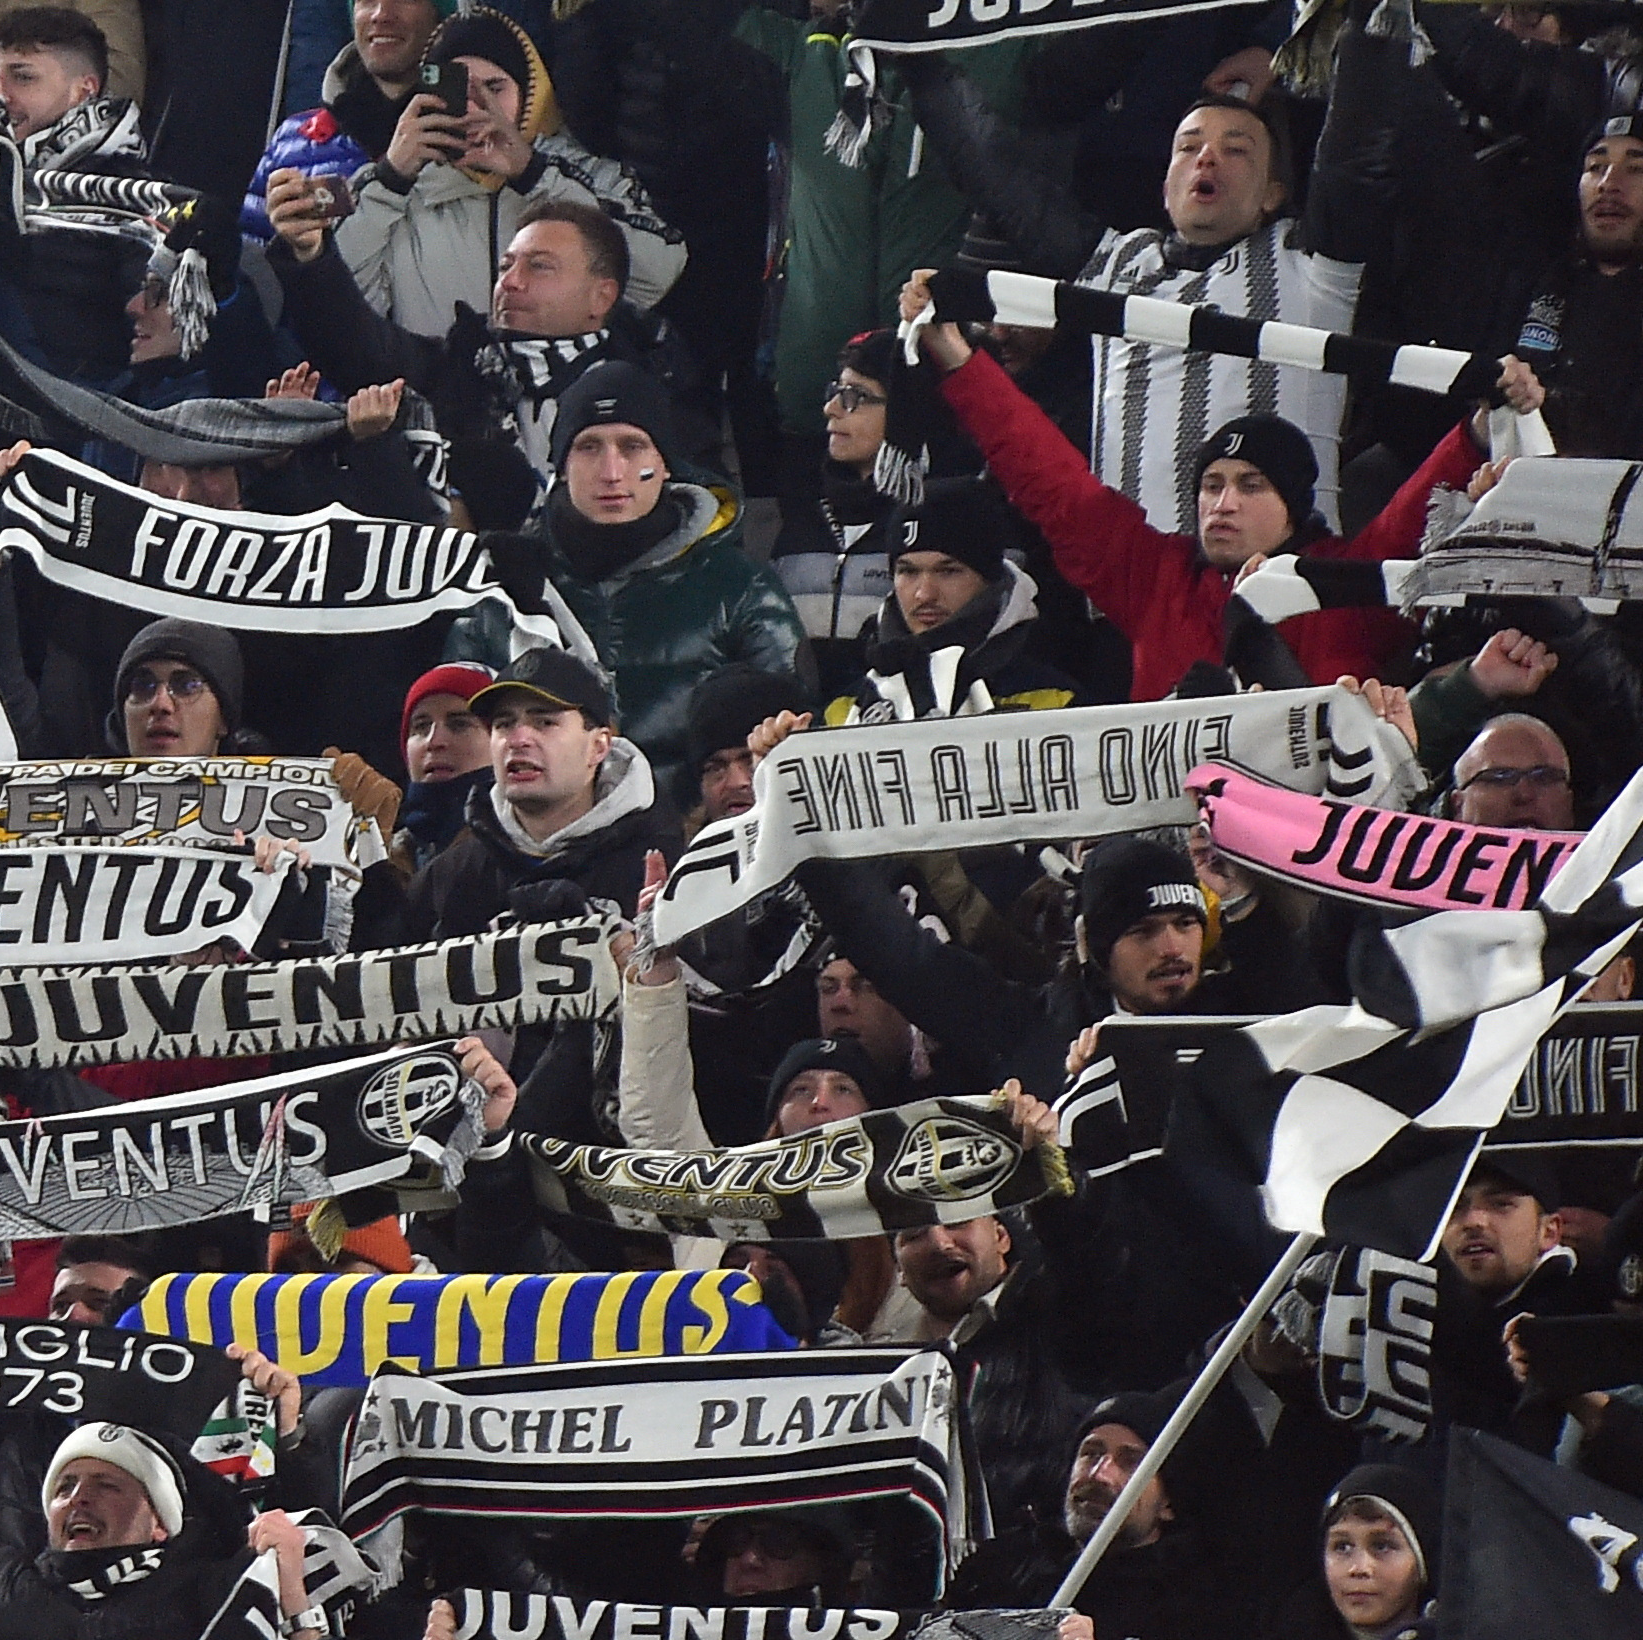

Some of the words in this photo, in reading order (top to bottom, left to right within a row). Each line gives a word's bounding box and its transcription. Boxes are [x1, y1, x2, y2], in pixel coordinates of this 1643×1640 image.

[130, 508, 333, 603] FORZA
[129, 760, 336, 788] CAMPION
[520, 1132, 870, 1192] JUVENTUS
[140, 1269, 765, 1374] JUVENTUS
[392, 1397, 632, 1455] MICHEL
[455, 1588, 901, 1640] JUVENTUS
